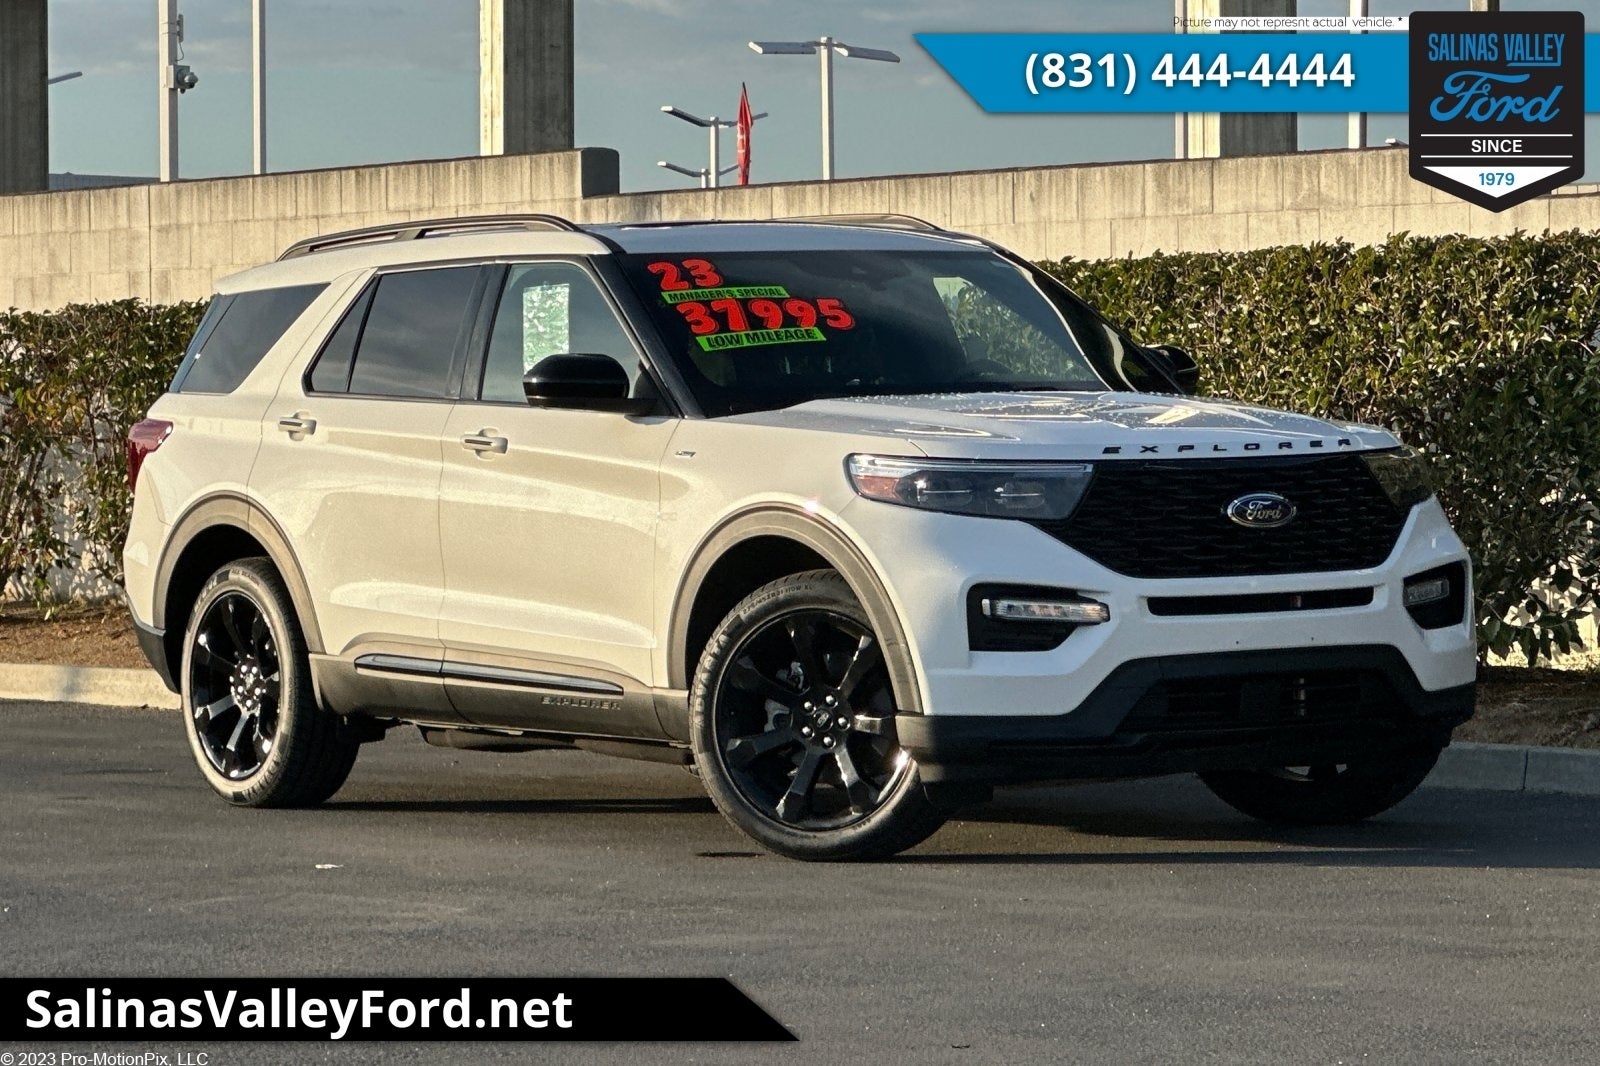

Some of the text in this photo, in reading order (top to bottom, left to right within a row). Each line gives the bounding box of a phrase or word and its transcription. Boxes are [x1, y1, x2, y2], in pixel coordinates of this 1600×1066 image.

[647, 258, 723, 291] 23
[668, 286, 785, 302] MANAGER'S SPECIAL
[706, 327, 818, 350] LOW MILEAGE
[1101, 438, 1352, 455] EXPLORER
[1245, 500, 1282, 521] Ford
